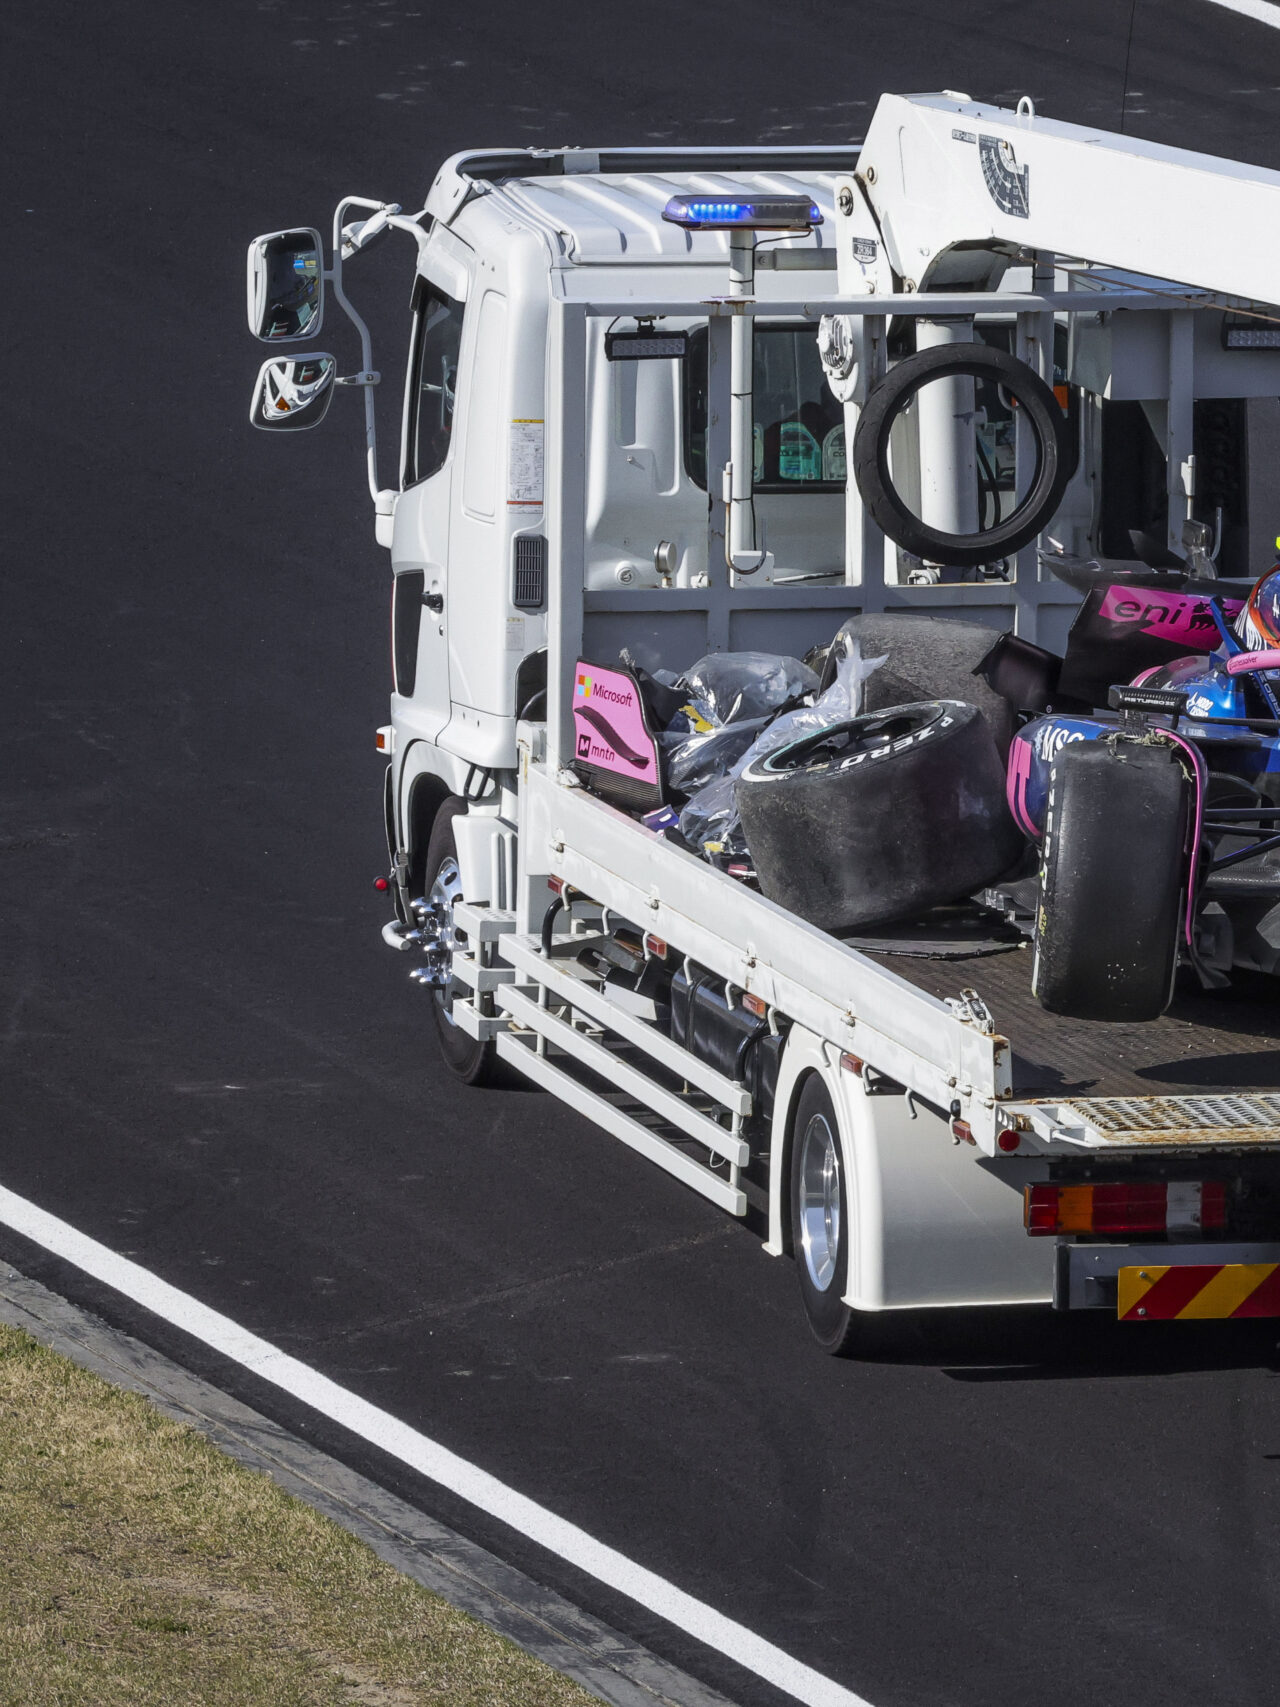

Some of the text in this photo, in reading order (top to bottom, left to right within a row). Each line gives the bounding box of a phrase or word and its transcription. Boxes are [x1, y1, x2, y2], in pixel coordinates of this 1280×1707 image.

[1114, 600, 1187, 625] eni
[592, 683, 633, 708] Microsoft
[590, 747, 615, 762] mntn
[840, 726, 936, 769] ZERO
